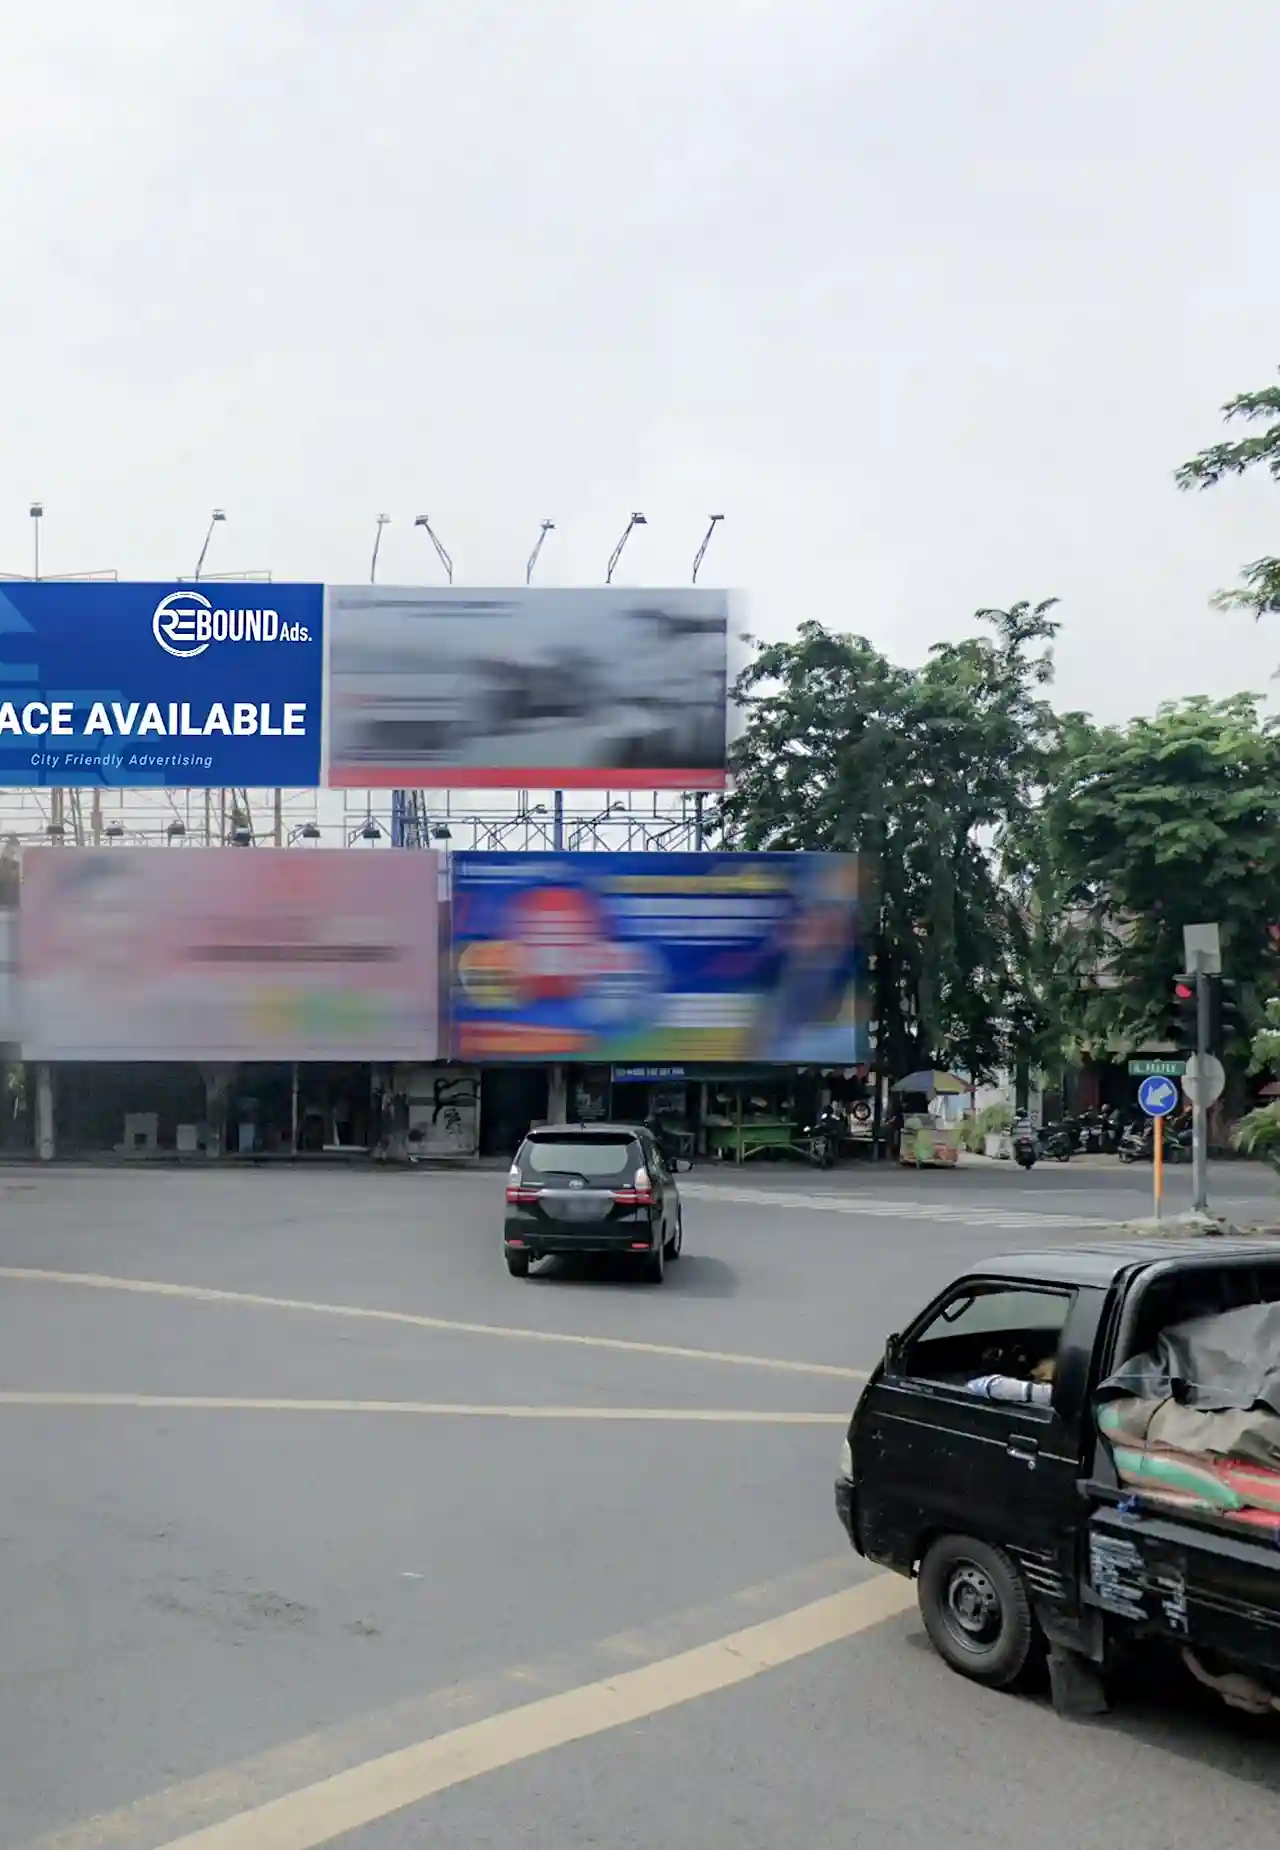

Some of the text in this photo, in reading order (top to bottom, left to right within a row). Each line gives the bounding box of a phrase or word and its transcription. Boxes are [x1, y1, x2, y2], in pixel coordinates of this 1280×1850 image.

[158, 609, 313, 642] REBOUND Ads.
[82, 702, 307, 736] AVAILABLE
[31, 753, 213, 769] City Friendly Advertising
